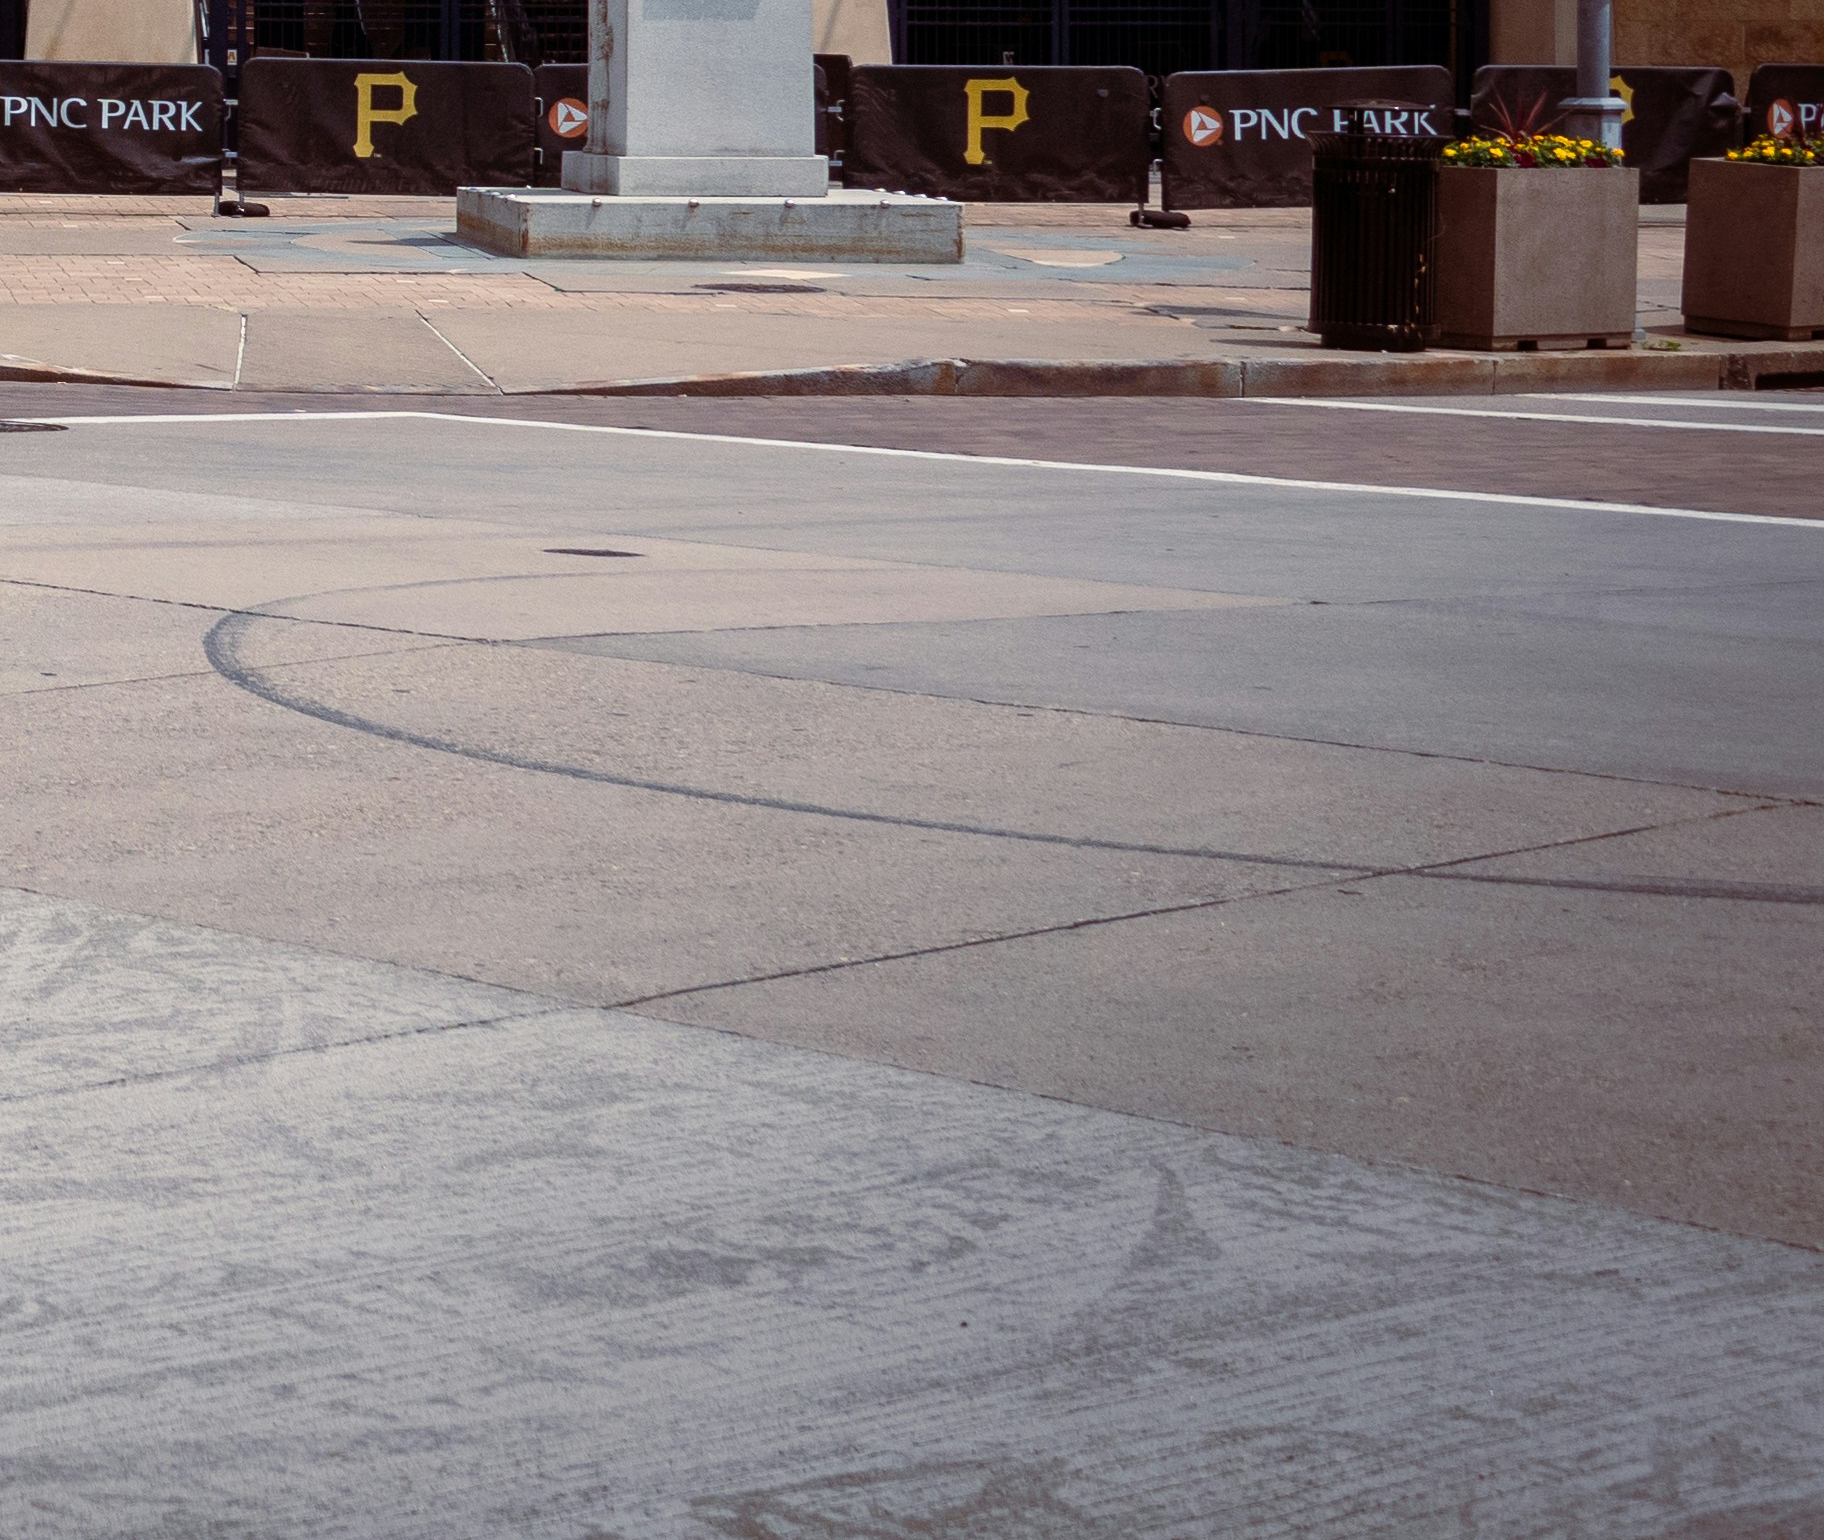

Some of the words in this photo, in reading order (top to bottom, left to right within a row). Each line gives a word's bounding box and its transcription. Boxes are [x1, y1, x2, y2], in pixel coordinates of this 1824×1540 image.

[0, 95, 88, 128] PNC
[97, 97, 203, 131] PARK
[353, 70, 419, 158] P
[963, 76, 1030, 165] P
[1228, 108, 1319, 141] PNC
